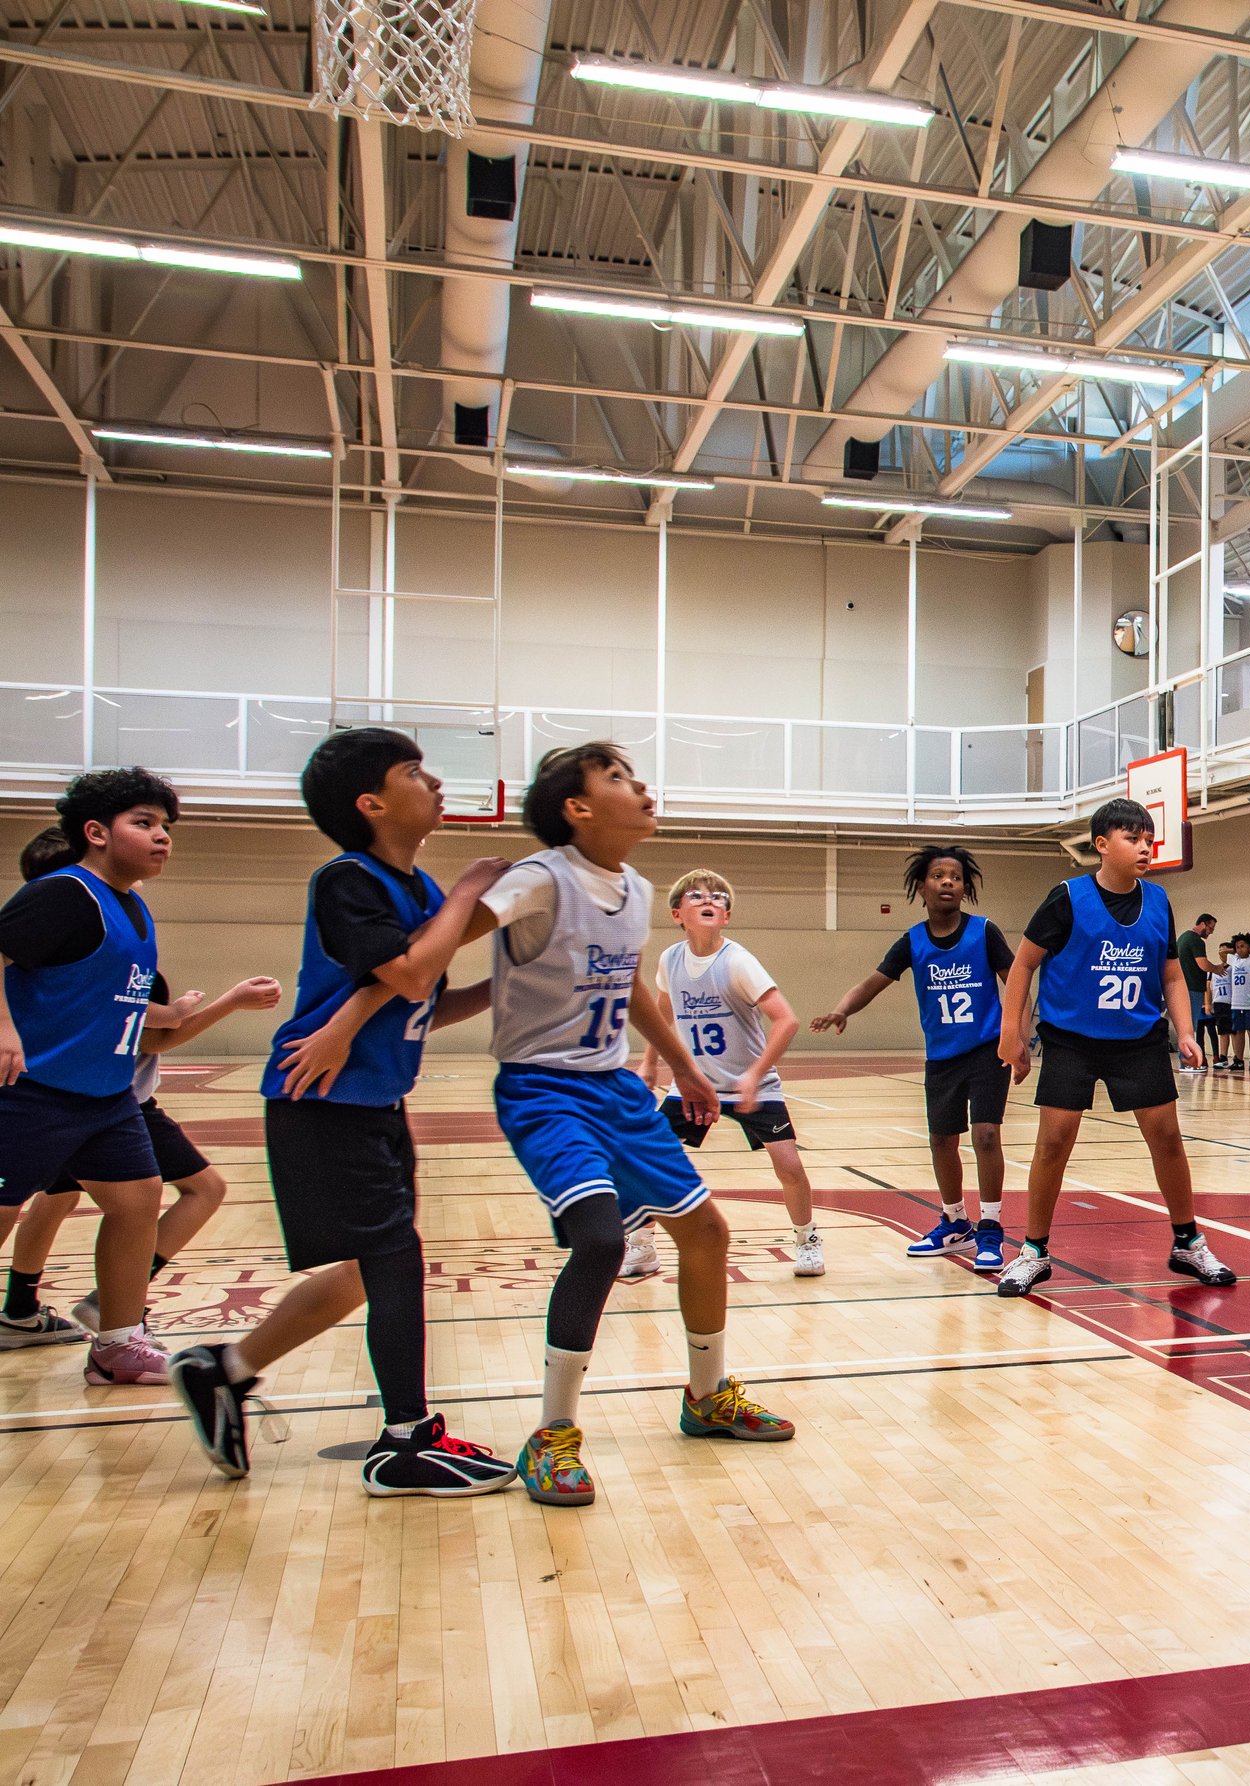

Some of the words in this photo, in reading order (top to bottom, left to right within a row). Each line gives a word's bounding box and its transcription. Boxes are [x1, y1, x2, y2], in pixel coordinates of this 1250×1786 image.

[1099, 940, 1145, 964] Rowlett
[927, 962, 973, 982] Rowlett
[1234, 975, 1246, 986] 20
[1098, 974, 1142, 1010] 20
[1219, 985, 1228, 996] 11
[937, 991, 974, 1024] 12
[579, 996, 627, 1049] 15
[690, 1022, 727, 1057] 13
